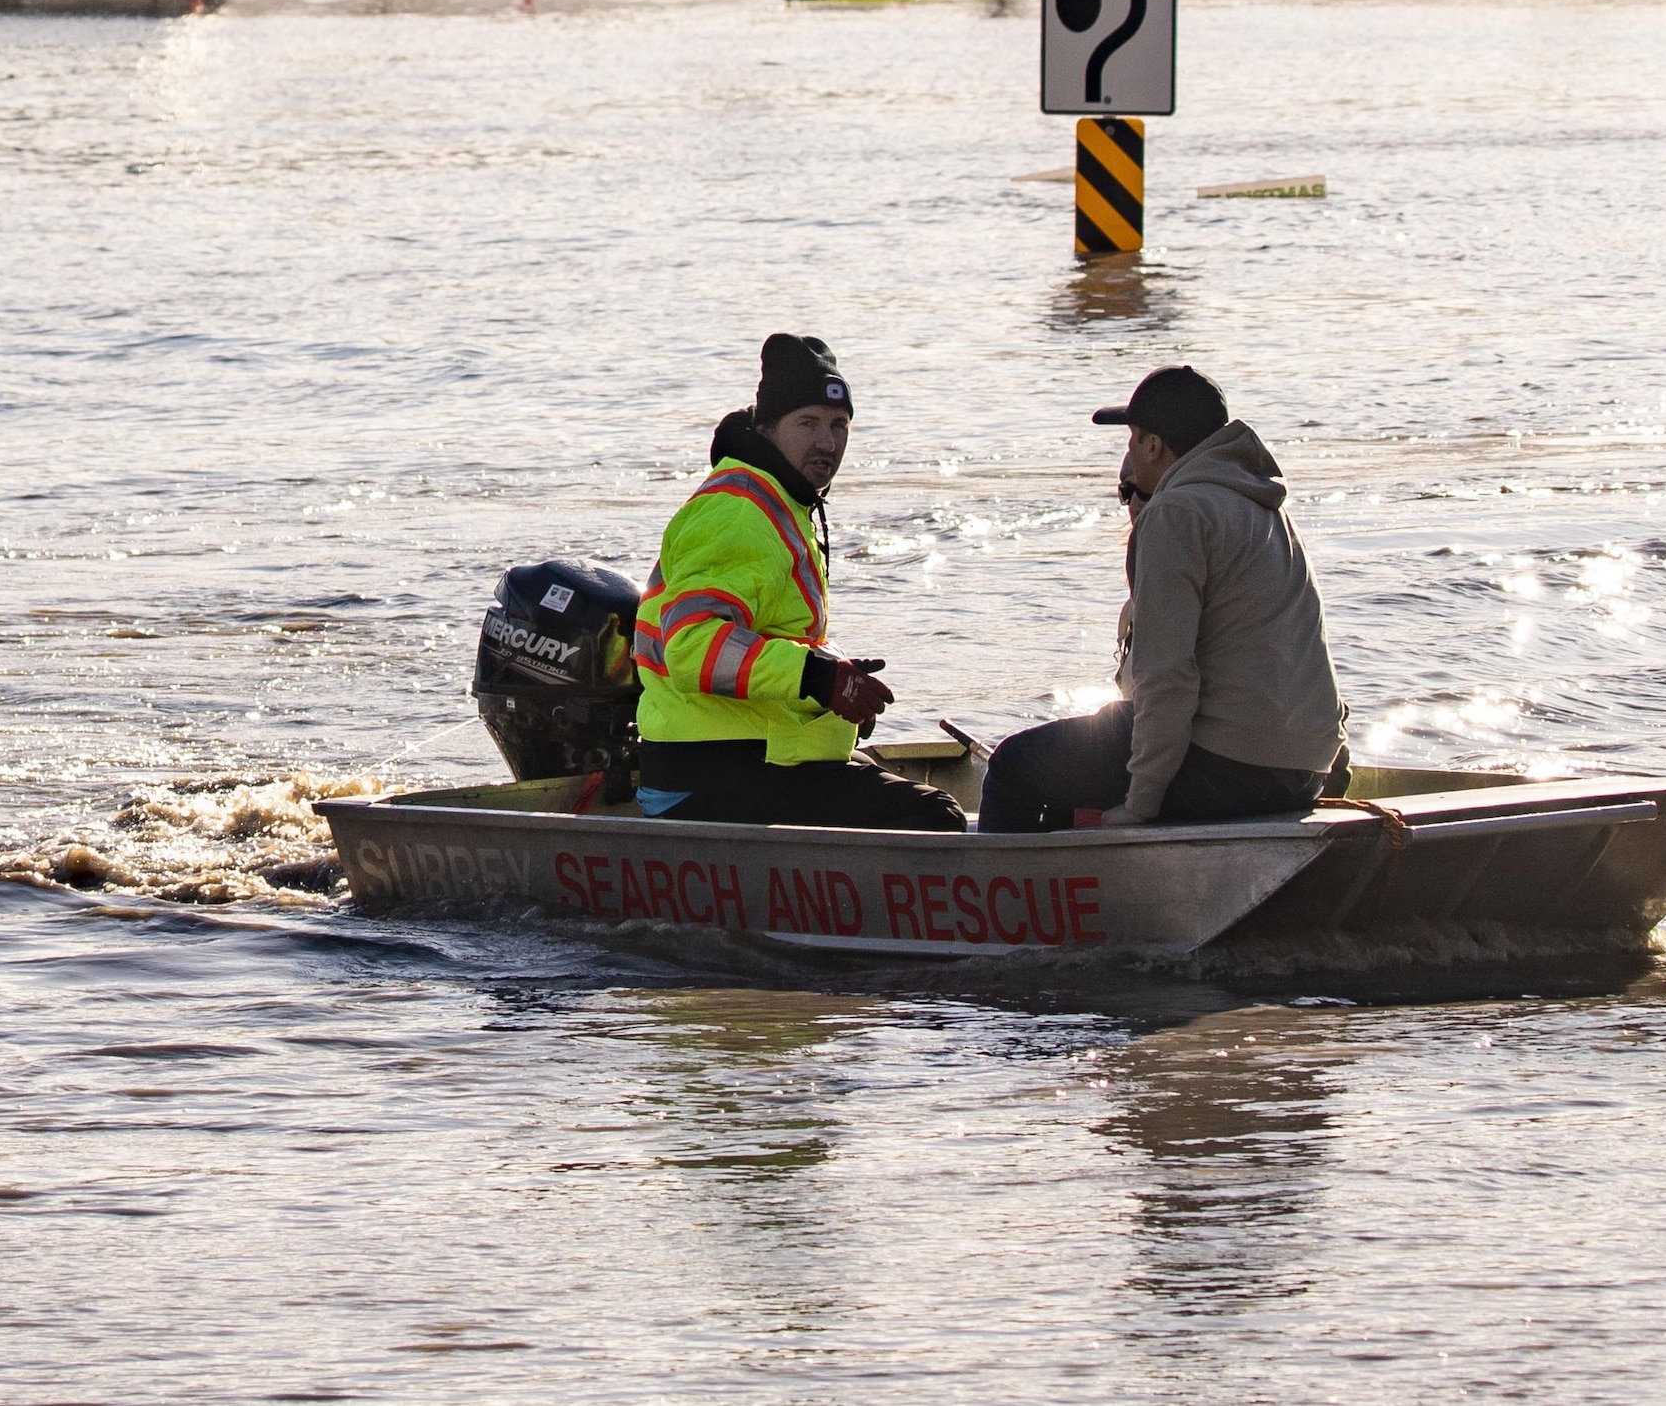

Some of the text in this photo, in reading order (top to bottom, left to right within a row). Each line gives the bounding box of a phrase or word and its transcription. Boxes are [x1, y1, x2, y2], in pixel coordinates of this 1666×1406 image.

[484, 612, 580, 663] MERCURY
[554, 851, 747, 930] SEARCH
[769, 867, 863, 936] AND
[883, 873, 1107, 945] RESCUE
